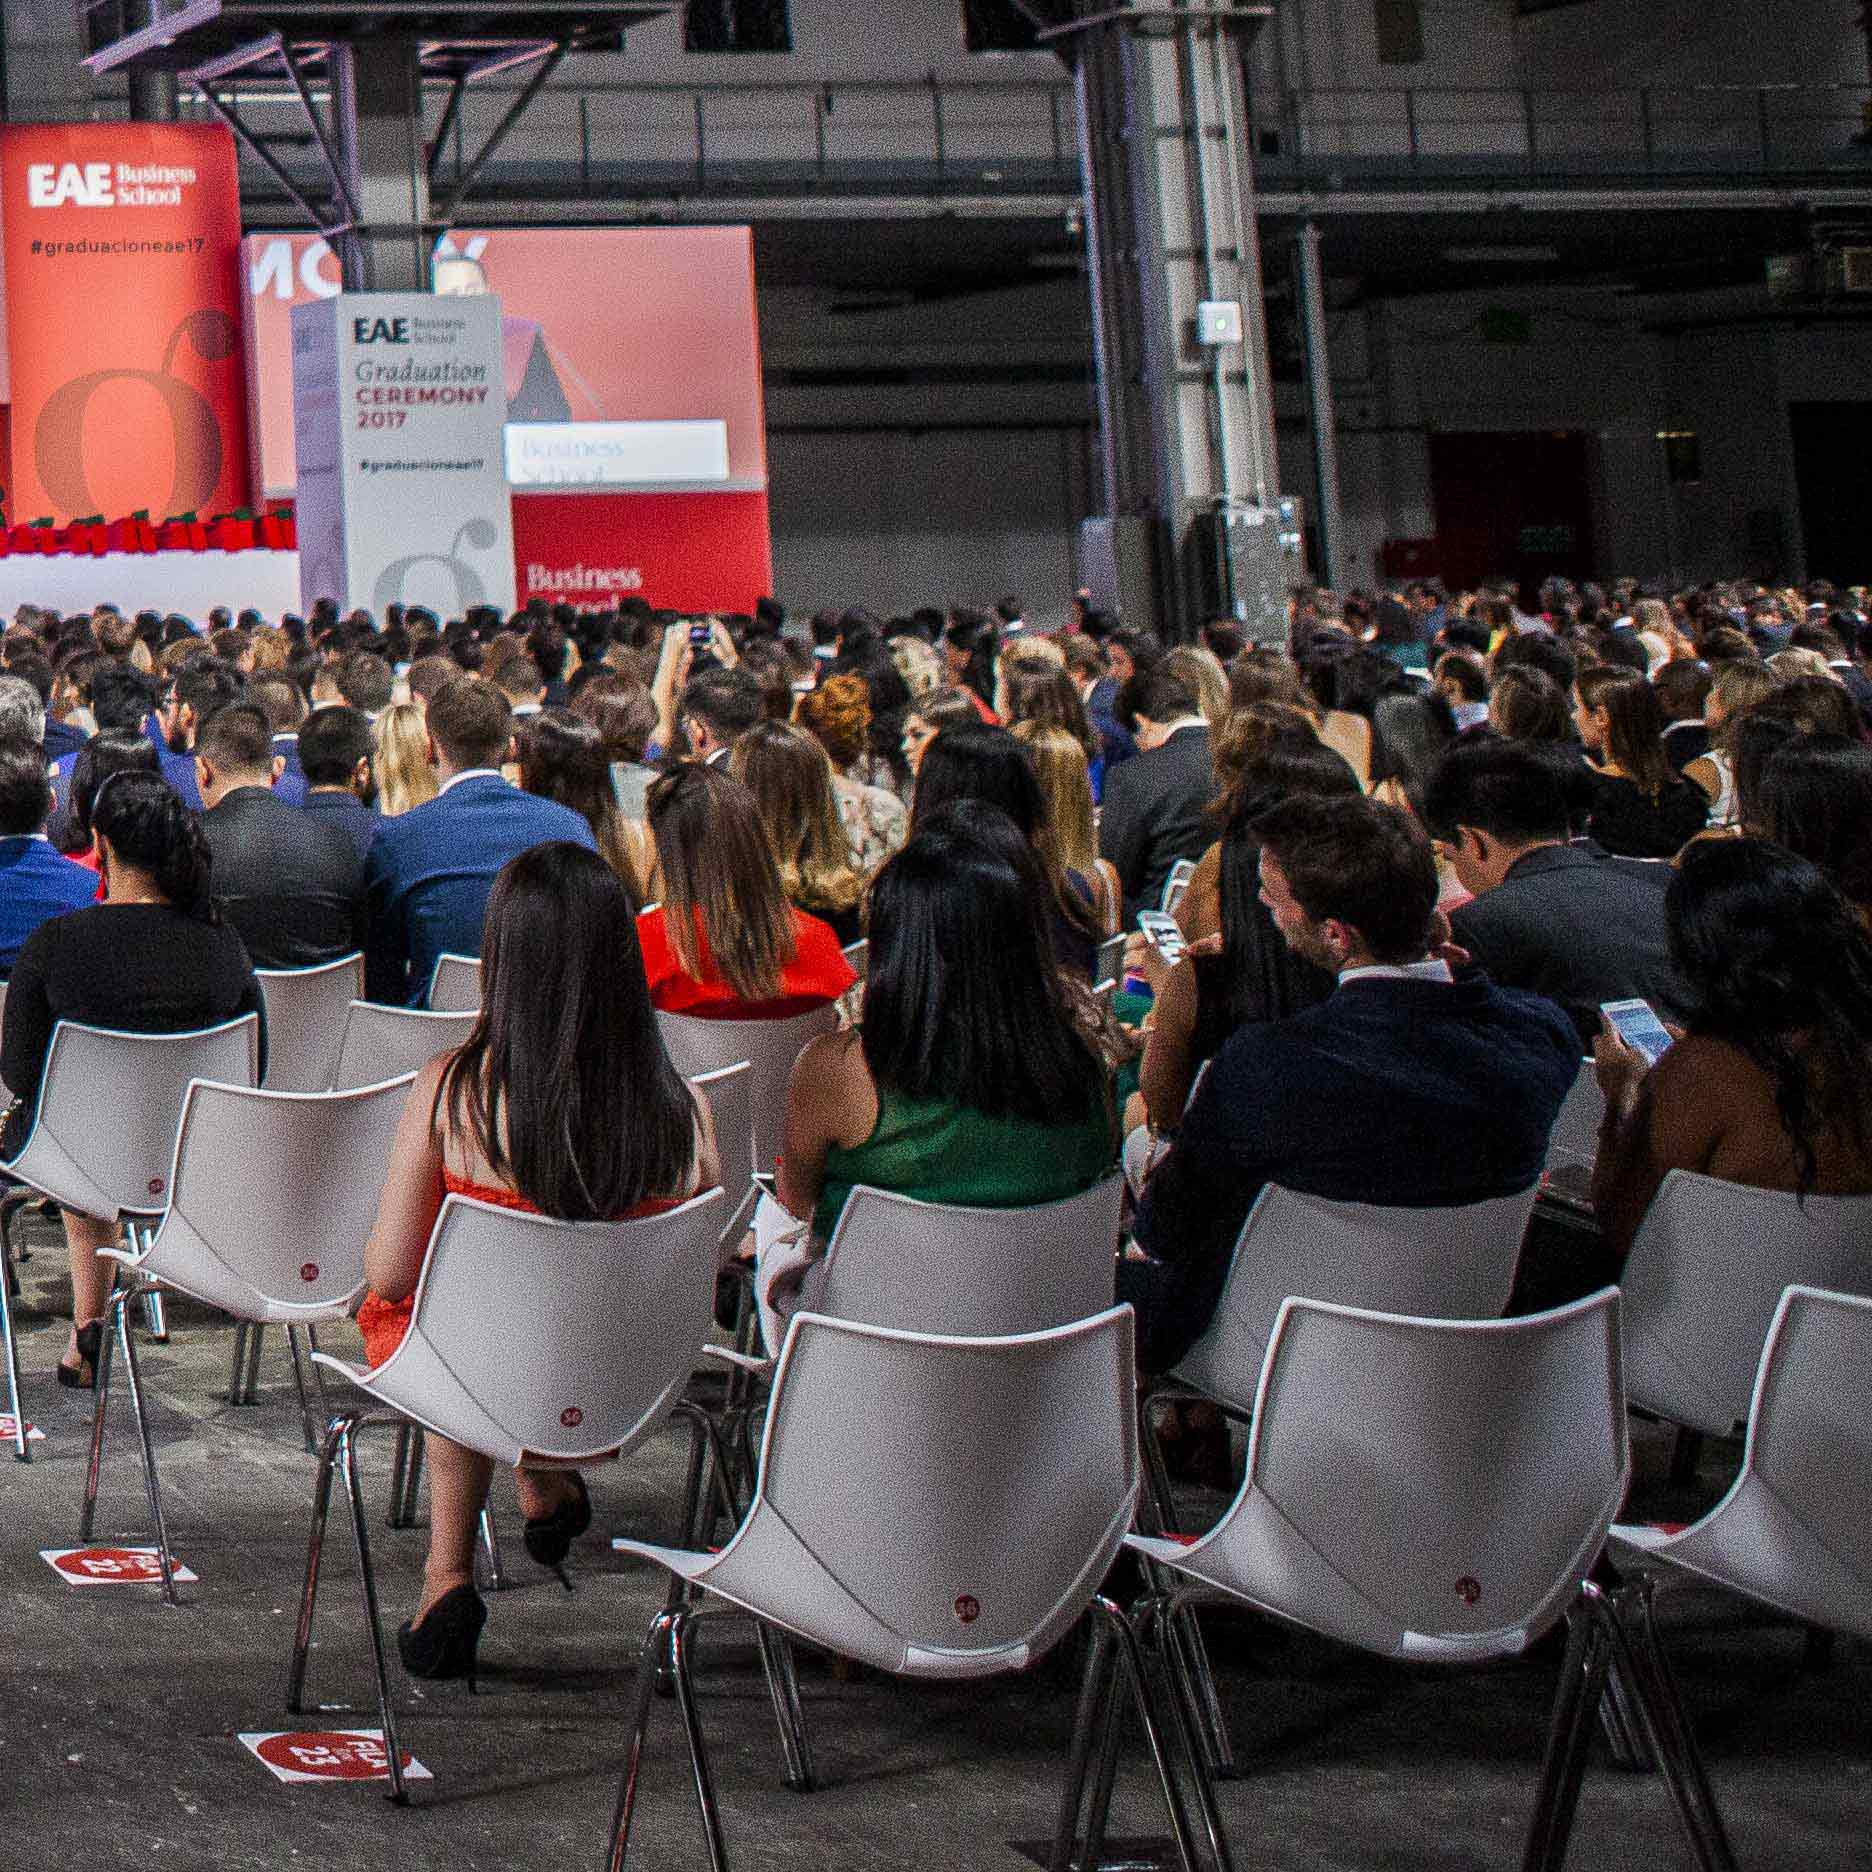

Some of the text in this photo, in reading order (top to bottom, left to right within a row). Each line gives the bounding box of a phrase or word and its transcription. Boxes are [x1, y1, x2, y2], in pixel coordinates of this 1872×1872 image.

[28, 162, 196, 208] EAE Business
[117, 185, 182, 205] School
[31, 238, 205, 257] #graduacioneae17
[354, 317, 410, 344] EAE
[357, 358, 487, 382] Graduation
[355, 385, 489, 405] CEREMONY
[357, 411, 407, 429] 2017
[522, 439, 625, 458] Business
[527, 562, 643, 590] Business
[288, 1745, 341, 1766] 23
[345, 1740, 388, 1769] FILA
